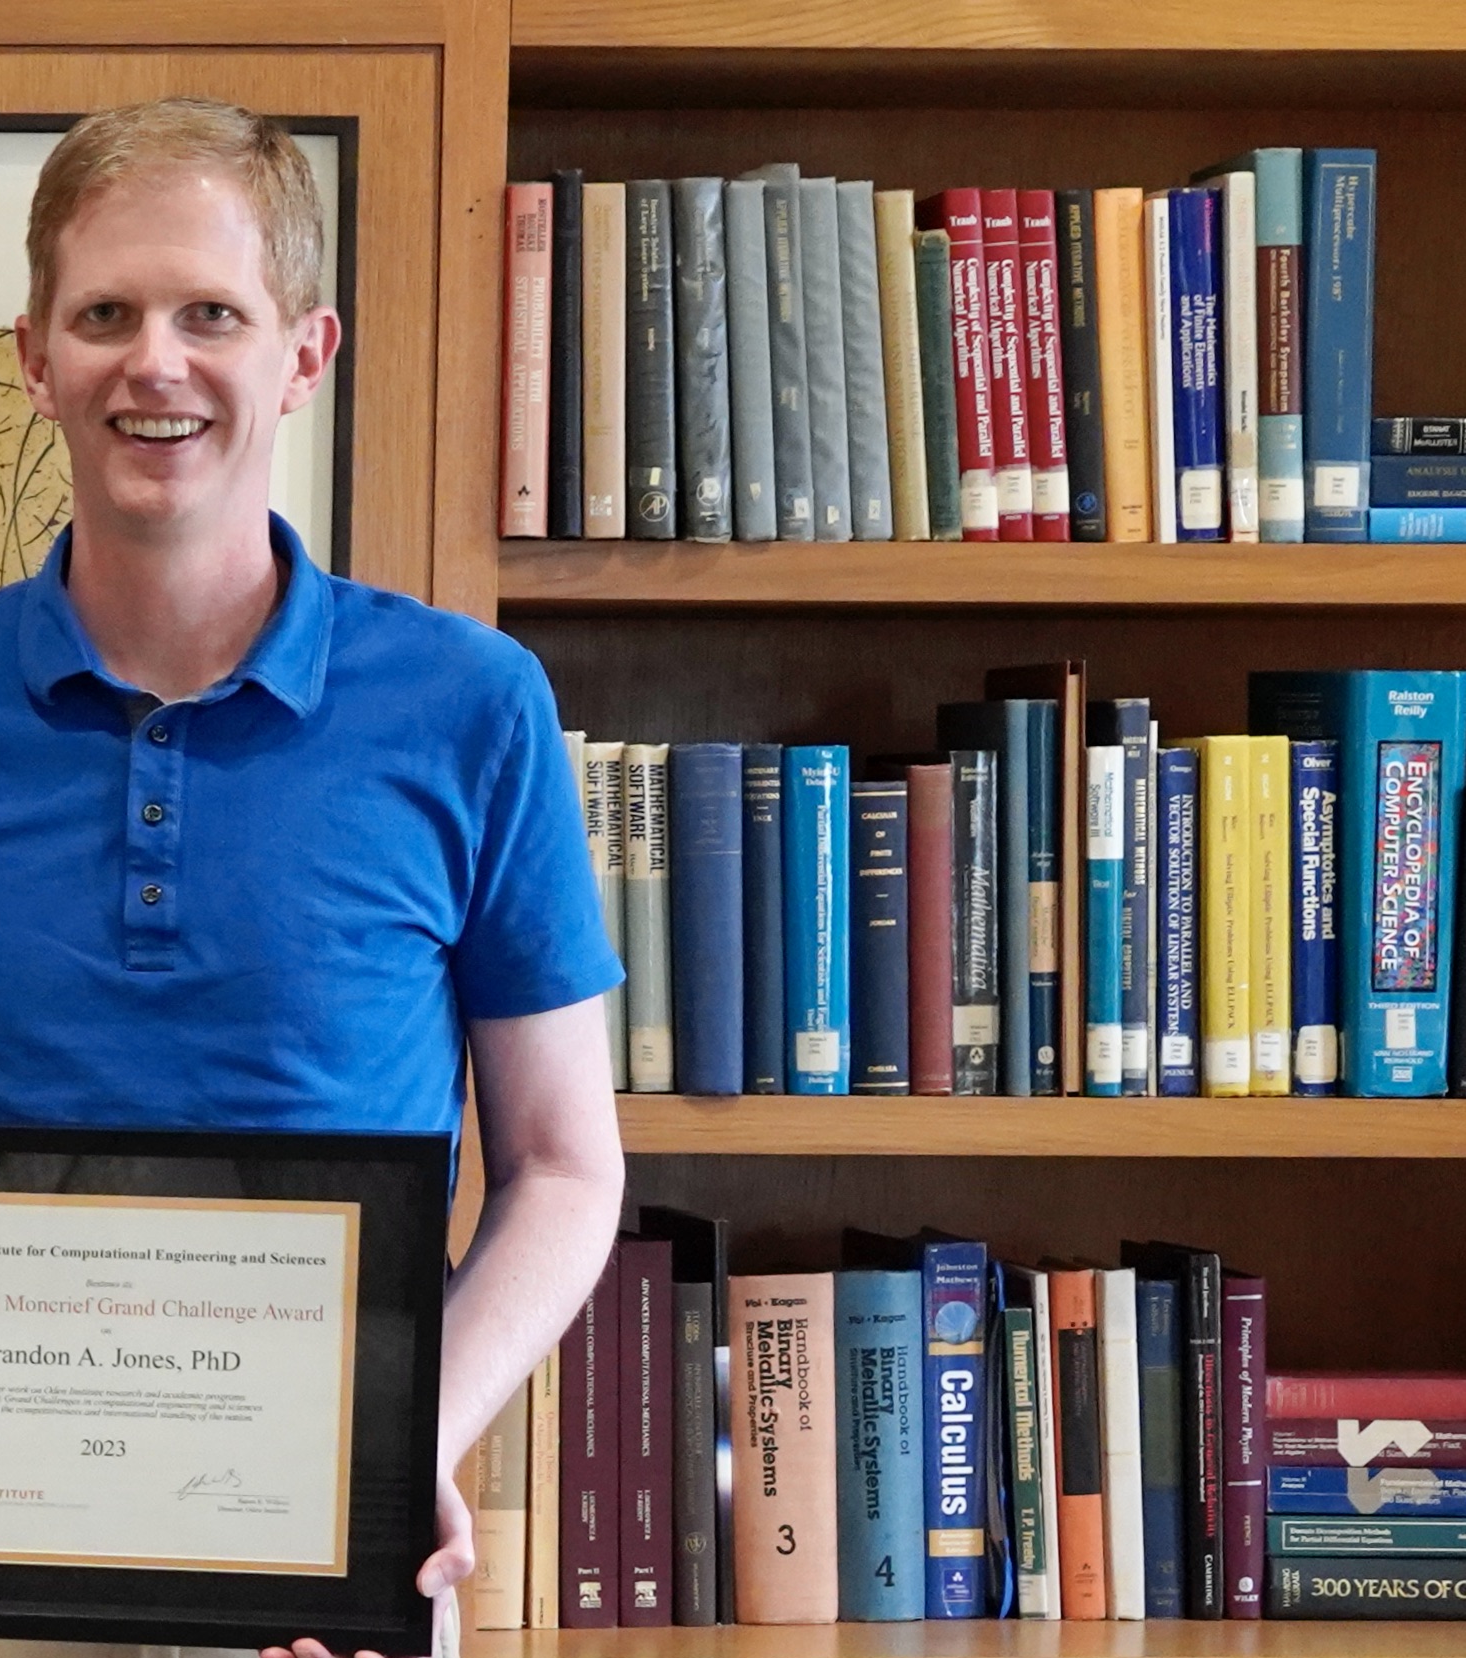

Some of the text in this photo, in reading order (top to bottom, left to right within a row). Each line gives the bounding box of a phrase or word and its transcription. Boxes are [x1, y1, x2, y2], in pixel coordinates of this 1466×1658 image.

[950, 214, 977, 226] Traub
[984, 215, 1012, 228] Traub
[1023, 215, 1052, 228] Traub
[1180, 294, 1193, 387] and Applications
[1193, 293, 1206, 394] of Finite Elements
[1205, 291, 1216, 386] The Mathematics
[1279, 248, 1291, 416] Fourth Berkeley Symposium
[1388, 690, 1434, 702] Ralston
[1393, 704, 1427, 718] Reilly
[629, 764, 645, 839] SOFTWARE
[1302, 756, 1331, 768] Olver
[649, 764, 666, 876] MATHEMATICAL
[1300, 786, 1319, 940] Special Functions
[1320, 790, 1335, 939] Asymptotics and
[1380, 760, 1404, 970] COMPUTER SCIENCE
[1403, 761, 1426, 961] ENCYCLOPEDIA OF
[969, 863, 989, 992] Mathematica
[1166, 794, 1180, 1040] VECTOR SOLUTION OF LINEAR SYSTEMS
[1180, 794, 1193, 1010] INTRODUCTION TO PARALLEL AND
[26, 1244, 46, 1257] for
[49, 1245, 151, 1261] Computational
[155, 1248, 236, 1265] Engineering
[240, 1252, 266, 1264] and
[269, 1252, 326, 1265] Sciences
[5, 1294, 94, 1314] Moncrief
[96, 1296, 155, 1316] Grand
[161, 1299, 256, 1323] Challenge
[262, 1303, 323, 1322] Award
[777, 1319, 793, 1389] Binary
[77, 1346, 102, 1367] A.
[111, 1347, 181, 1370] Jones,
[191, 1349, 241, 1371] PhD
[795, 1318, 812, 1431] Handbook of
[879, 1347, 894, 1414] Binary
[896, 1345, 910, 1455] Handbook of
[1013, 1330, 1033, 1480] Numerical Methods
[80, 1438, 126, 1457] 2023
[757, 1320, 779, 1498] Metallic Systems
[860, 1348, 881, 1521] Metallic Systems
[942, 1370, 973, 1514] Calculus
[775, 1523, 796, 1555] 3
[873, 1555, 894, 1587] 4
[1311, 1577, 1452, 1599] 300 YEARS OF
